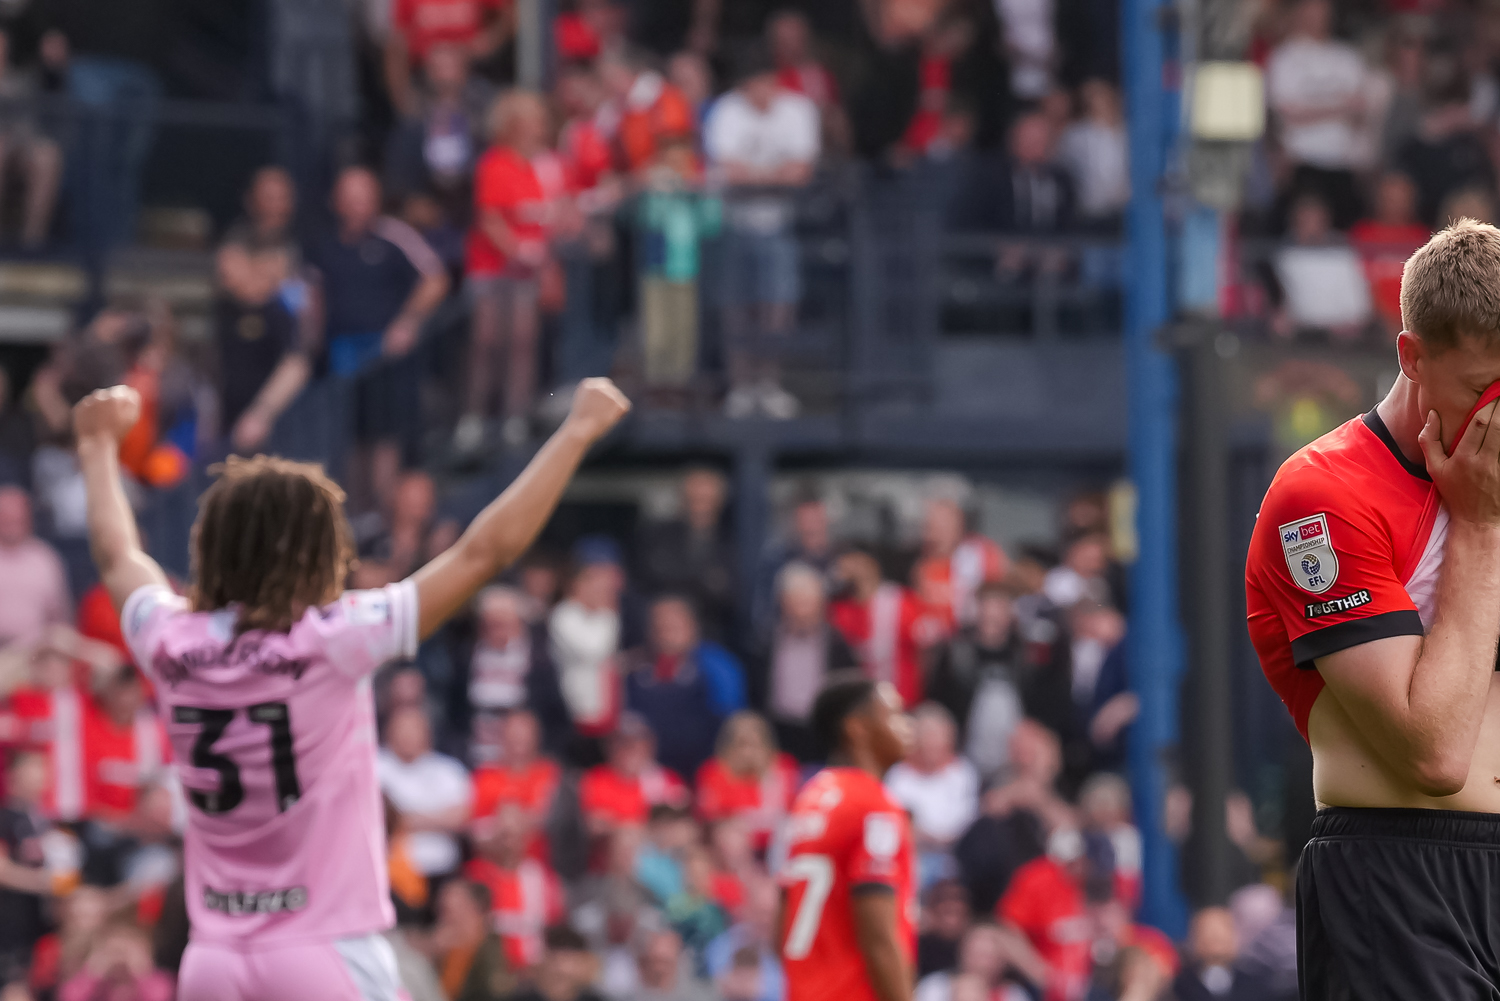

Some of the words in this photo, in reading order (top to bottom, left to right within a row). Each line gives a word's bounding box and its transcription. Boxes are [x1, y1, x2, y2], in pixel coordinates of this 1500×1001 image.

[1284, 530, 1299, 542] sky
[1300, 524, 1321, 537] bet
[1286, 537, 1325, 554] CHAMPIONSHIP
[1308, 575, 1326, 587] EFL
[173, 701, 300, 815] 31
